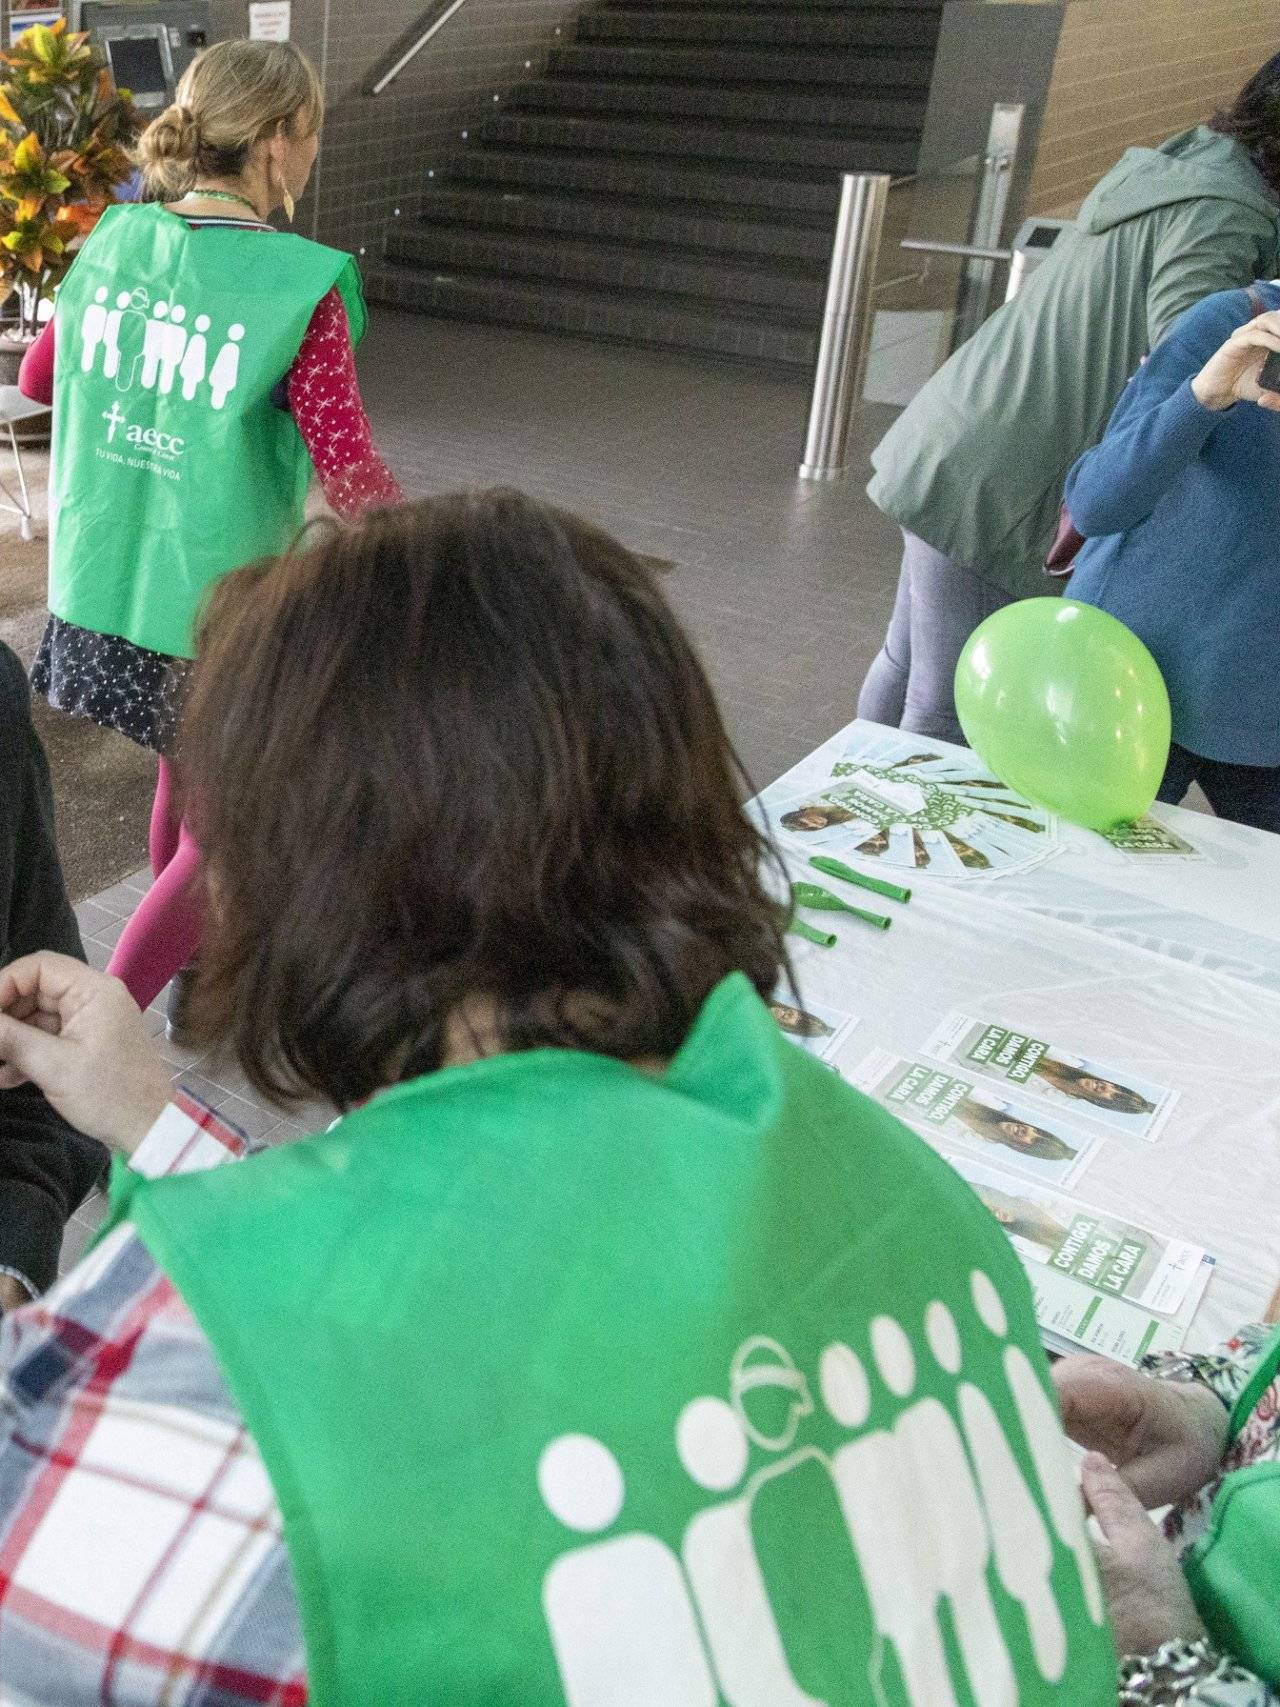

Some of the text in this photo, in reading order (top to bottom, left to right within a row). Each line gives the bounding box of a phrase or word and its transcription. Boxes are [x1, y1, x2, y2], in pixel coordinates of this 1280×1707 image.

[125, 424, 185, 455] aecc
[970, 1027, 1005, 1061] LA CARA
[995, 1034, 1026, 1065] DAMOS
[889, 1066, 929, 1101] LA CARA
[915, 1074, 949, 1106] DAMOS
[1052, 1220, 1097, 1269] CONTIGO,
[1076, 1239, 1112, 1280] DAMOS
[1103, 1244, 1141, 1292] LA CARA
